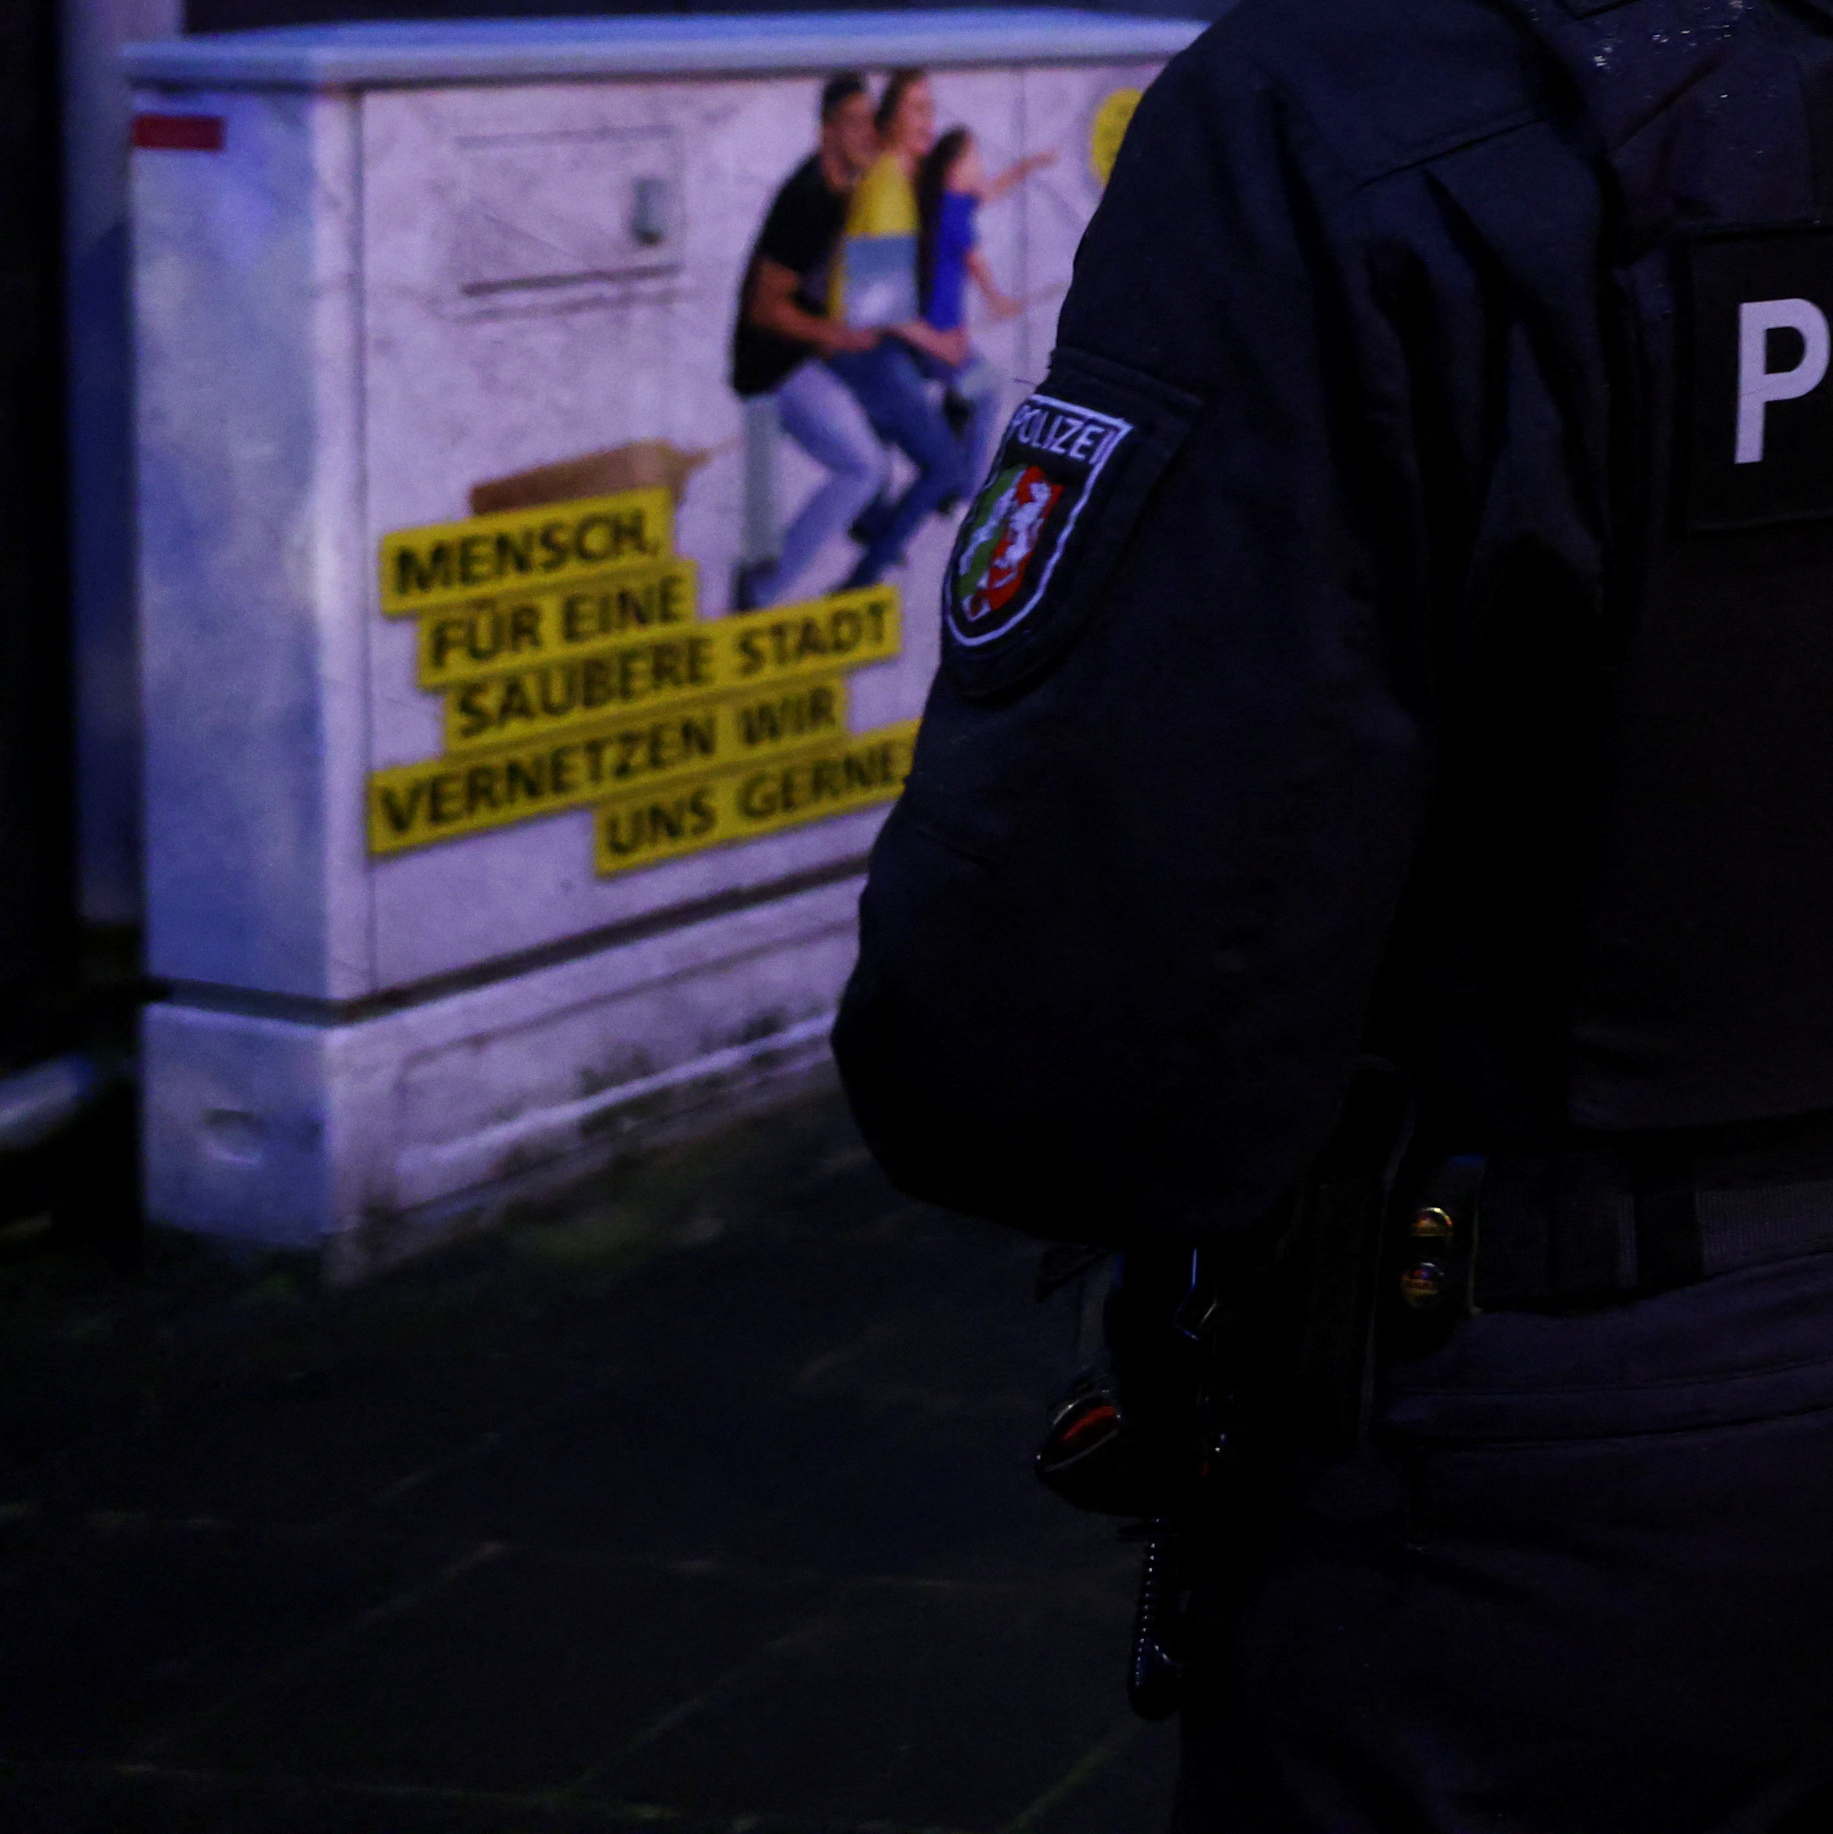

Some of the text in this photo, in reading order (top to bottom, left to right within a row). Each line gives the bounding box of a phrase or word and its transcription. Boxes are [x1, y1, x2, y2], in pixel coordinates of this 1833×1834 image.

[1011, 404, 1116, 465] POLIZEI
[430, 575, 685, 669] FÜR EINE
[456, 600, 892, 739] SAUBERE STADT
[378, 687, 836, 833] VERNETZEN WIR
[604, 741, 895, 858] UNS GERNE
